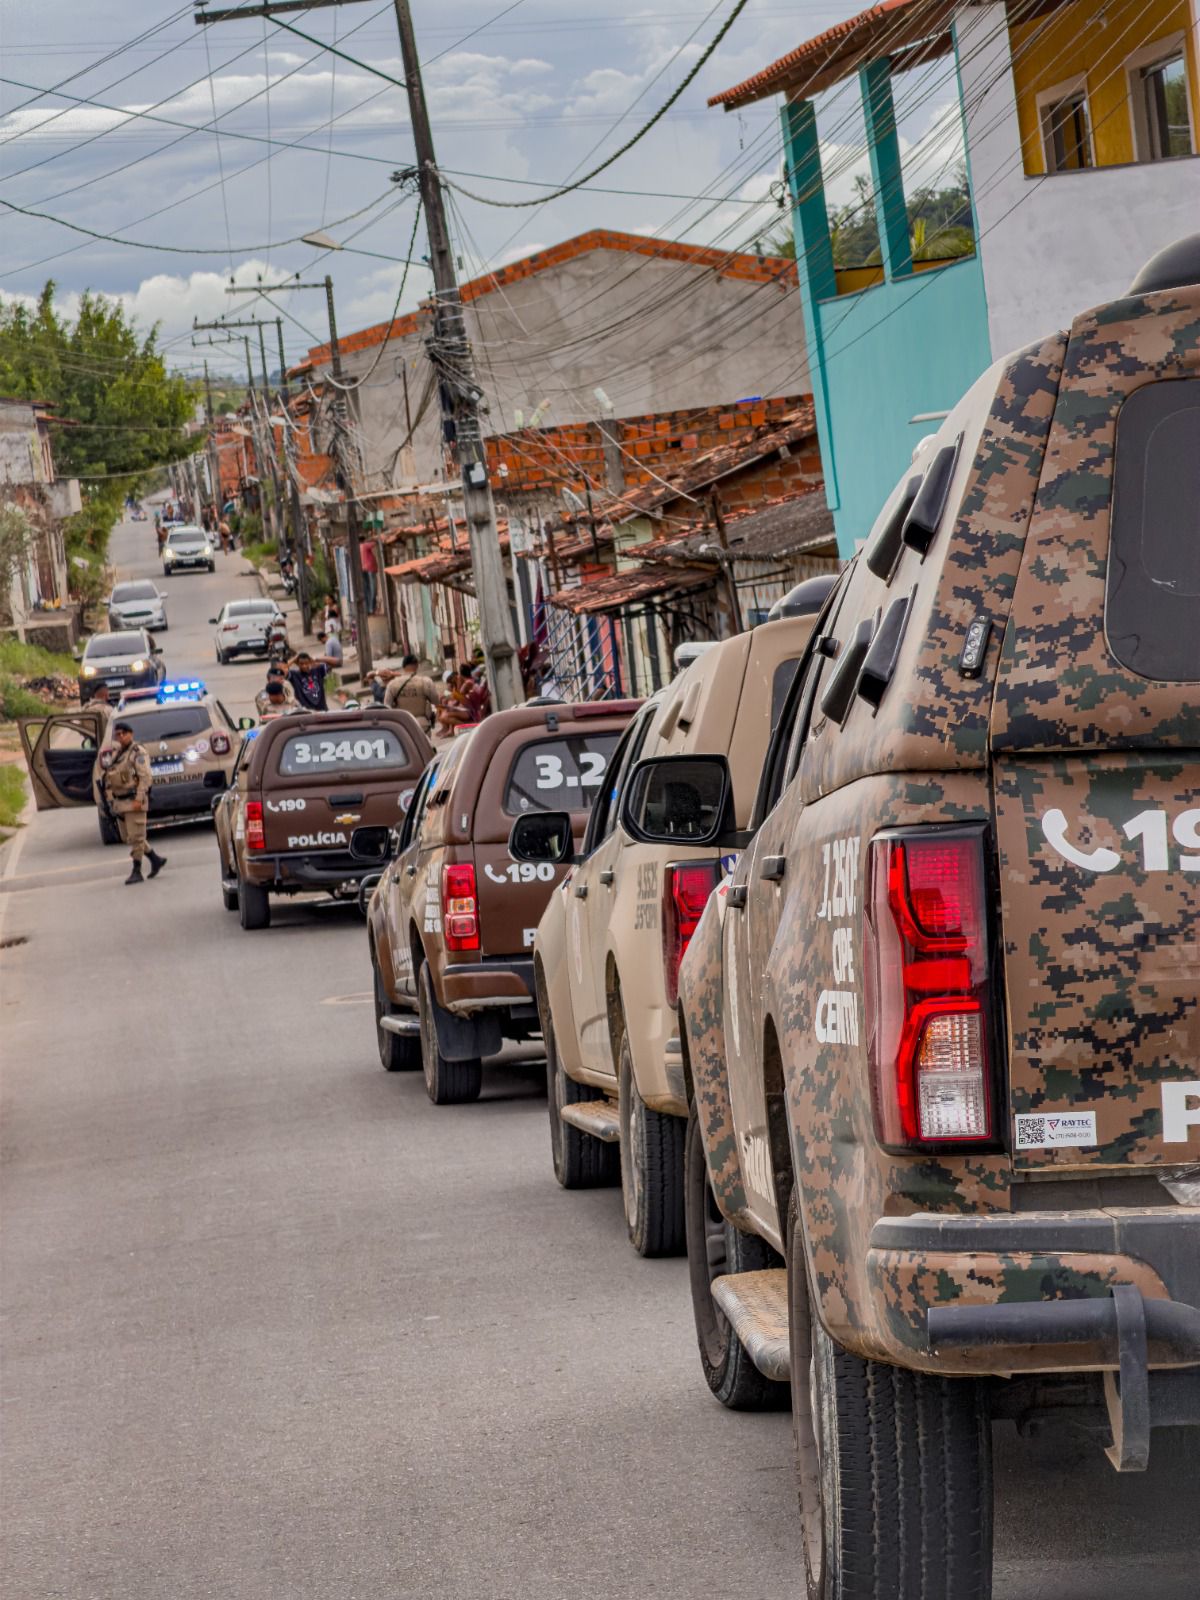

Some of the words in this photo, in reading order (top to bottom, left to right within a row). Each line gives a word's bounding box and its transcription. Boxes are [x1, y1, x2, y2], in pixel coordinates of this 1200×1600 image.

[294, 739, 386, 764] 3.2401
[280, 798, 306, 811] 190
[287, 831, 347, 848] POLÍCIA
[506, 862, 555, 883] 190
[1061, 1118, 1092, 1127] RAYTEC
